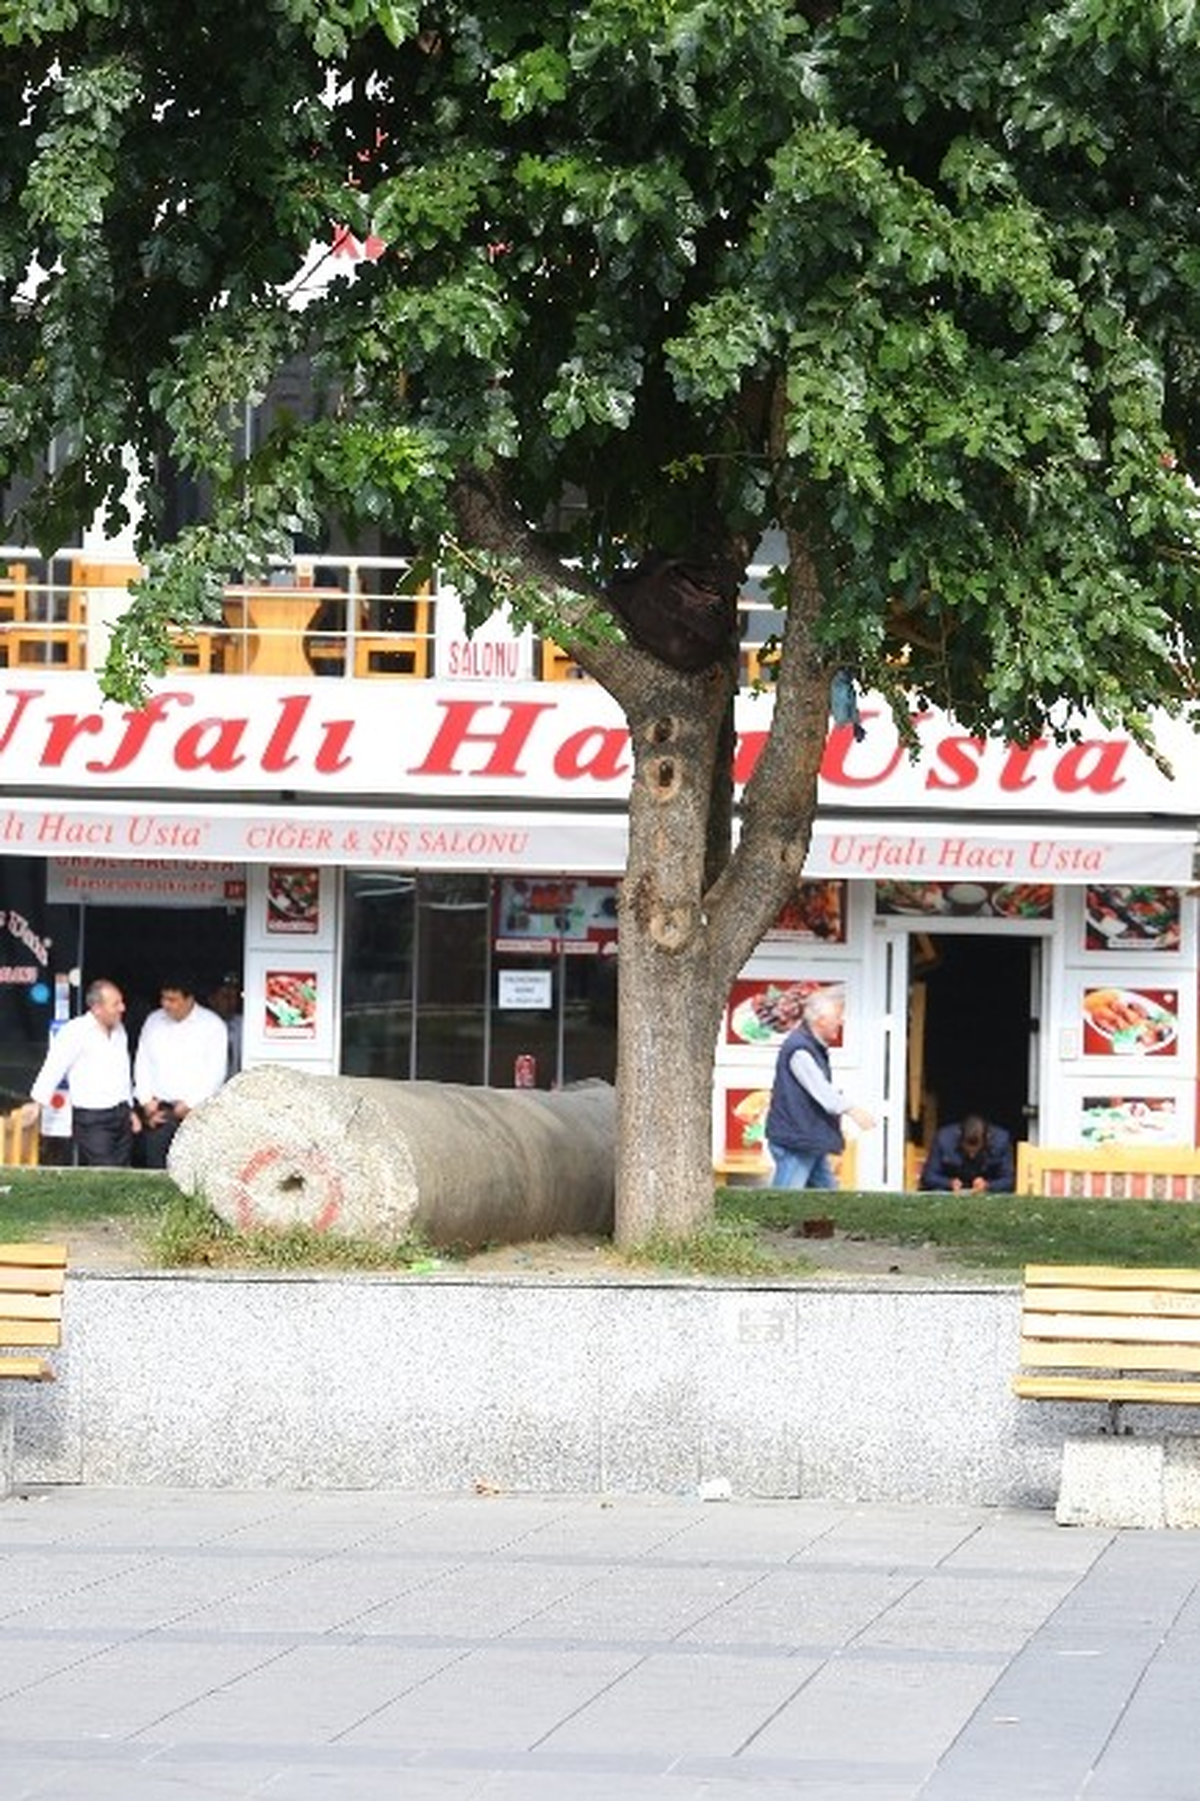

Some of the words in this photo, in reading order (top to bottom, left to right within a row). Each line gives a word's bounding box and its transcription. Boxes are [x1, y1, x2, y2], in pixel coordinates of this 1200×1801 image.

[448, 640, 520, 678] SALONU
[406, 699, 772, 784] Haı
[818, 708, 1130, 794] Usta
[37, 813, 114, 843] Hacı
[127, 815, 203, 847] Usta
[342, 828, 361, 852] &
[416, 829, 530, 855] SALONU
[828, 836, 926, 871] Urfalı
[936, 839, 1017, 868] Hacı
[1028, 841, 1105, 872] Usta
